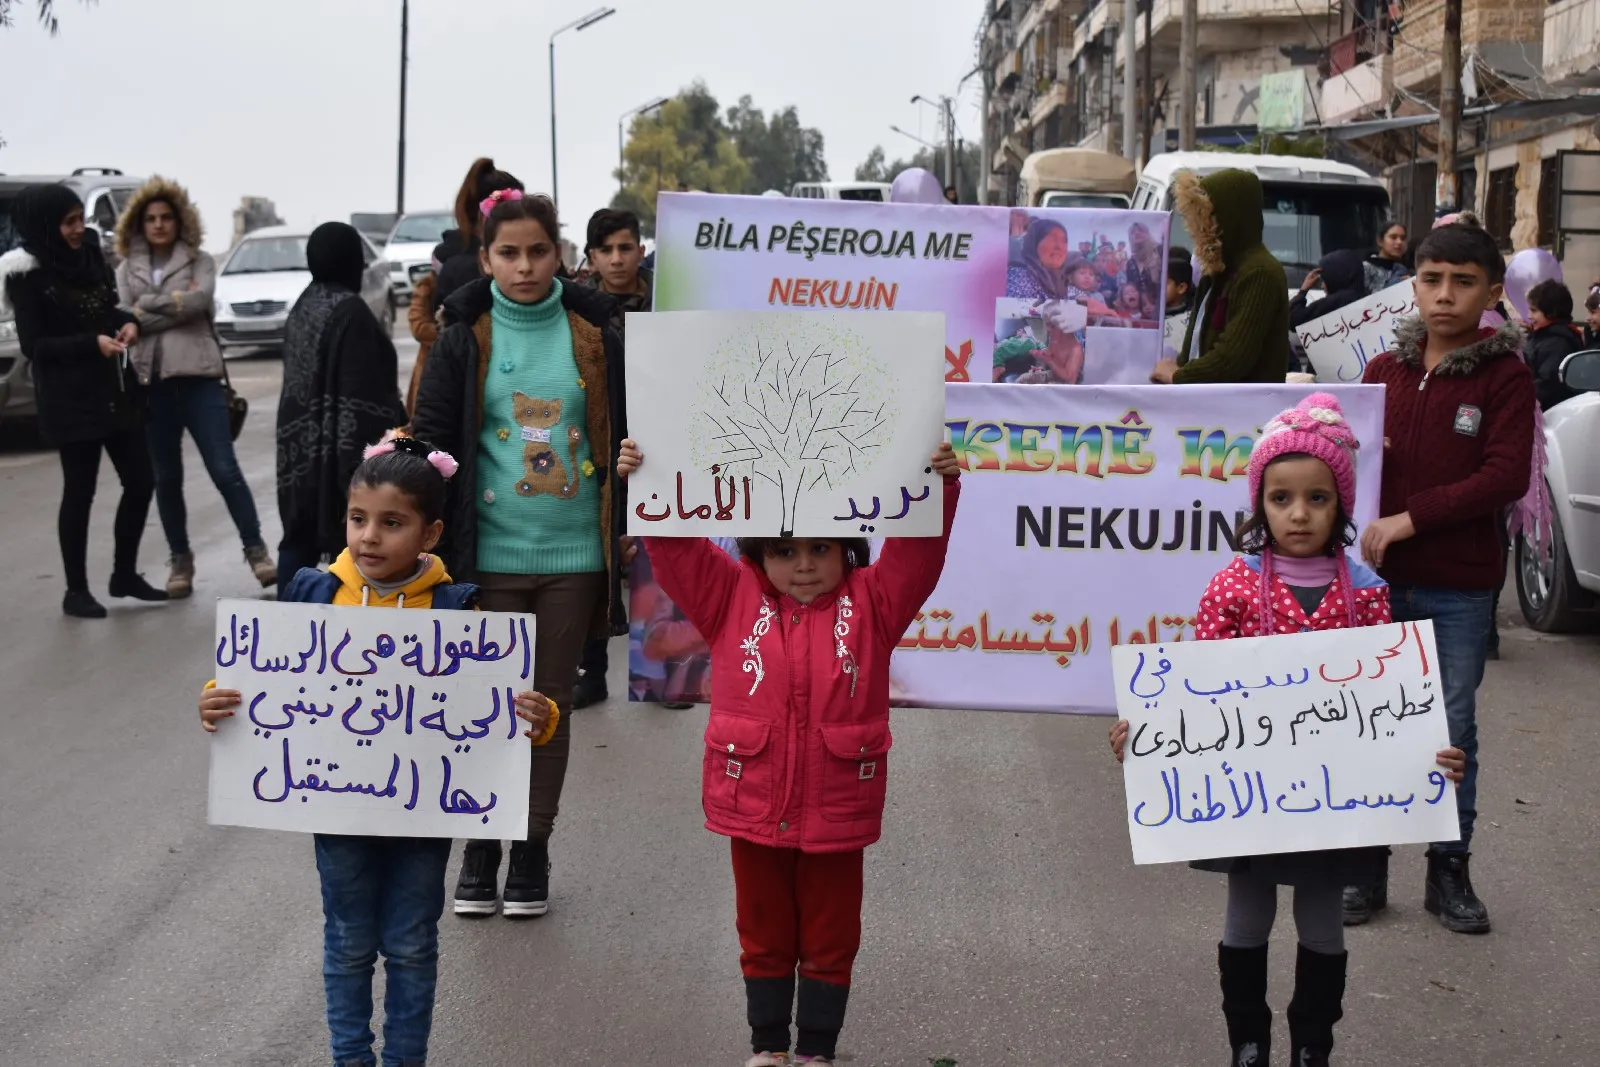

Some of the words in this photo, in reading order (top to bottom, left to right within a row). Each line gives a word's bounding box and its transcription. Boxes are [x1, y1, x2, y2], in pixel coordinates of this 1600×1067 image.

[694, 217, 760, 251] BİLA
[766, 220, 917, 262] PÊŞEROJA
[923, 231, 973, 260] ME
[767, 276, 899, 310] NEKUJİN
[635, 463, 751, 522] الأمان
[833, 466, 932, 533] نريد
[1015, 499, 1248, 553] NEKUJİN
[216, 614, 326, 674] الرسائل
[331, 628, 396, 686] هي
[401, 617, 530, 680] الطفولة
[1319, 621, 1429, 687] الحرب
[1129, 646, 1172, 709] في
[1183, 667, 1309, 705] سبب
[248, 685, 338, 740] نبني
[341, 683, 415, 746] التي
[419, 686, 517, 753] الحية
[1290, 690, 1365, 746] القيم
[1369, 681, 1435, 740] تحطيم
[253, 738, 419, 811] المستقبل
[439, 755, 498, 824] بها
[1133, 761, 1269, 827] الأطفال
